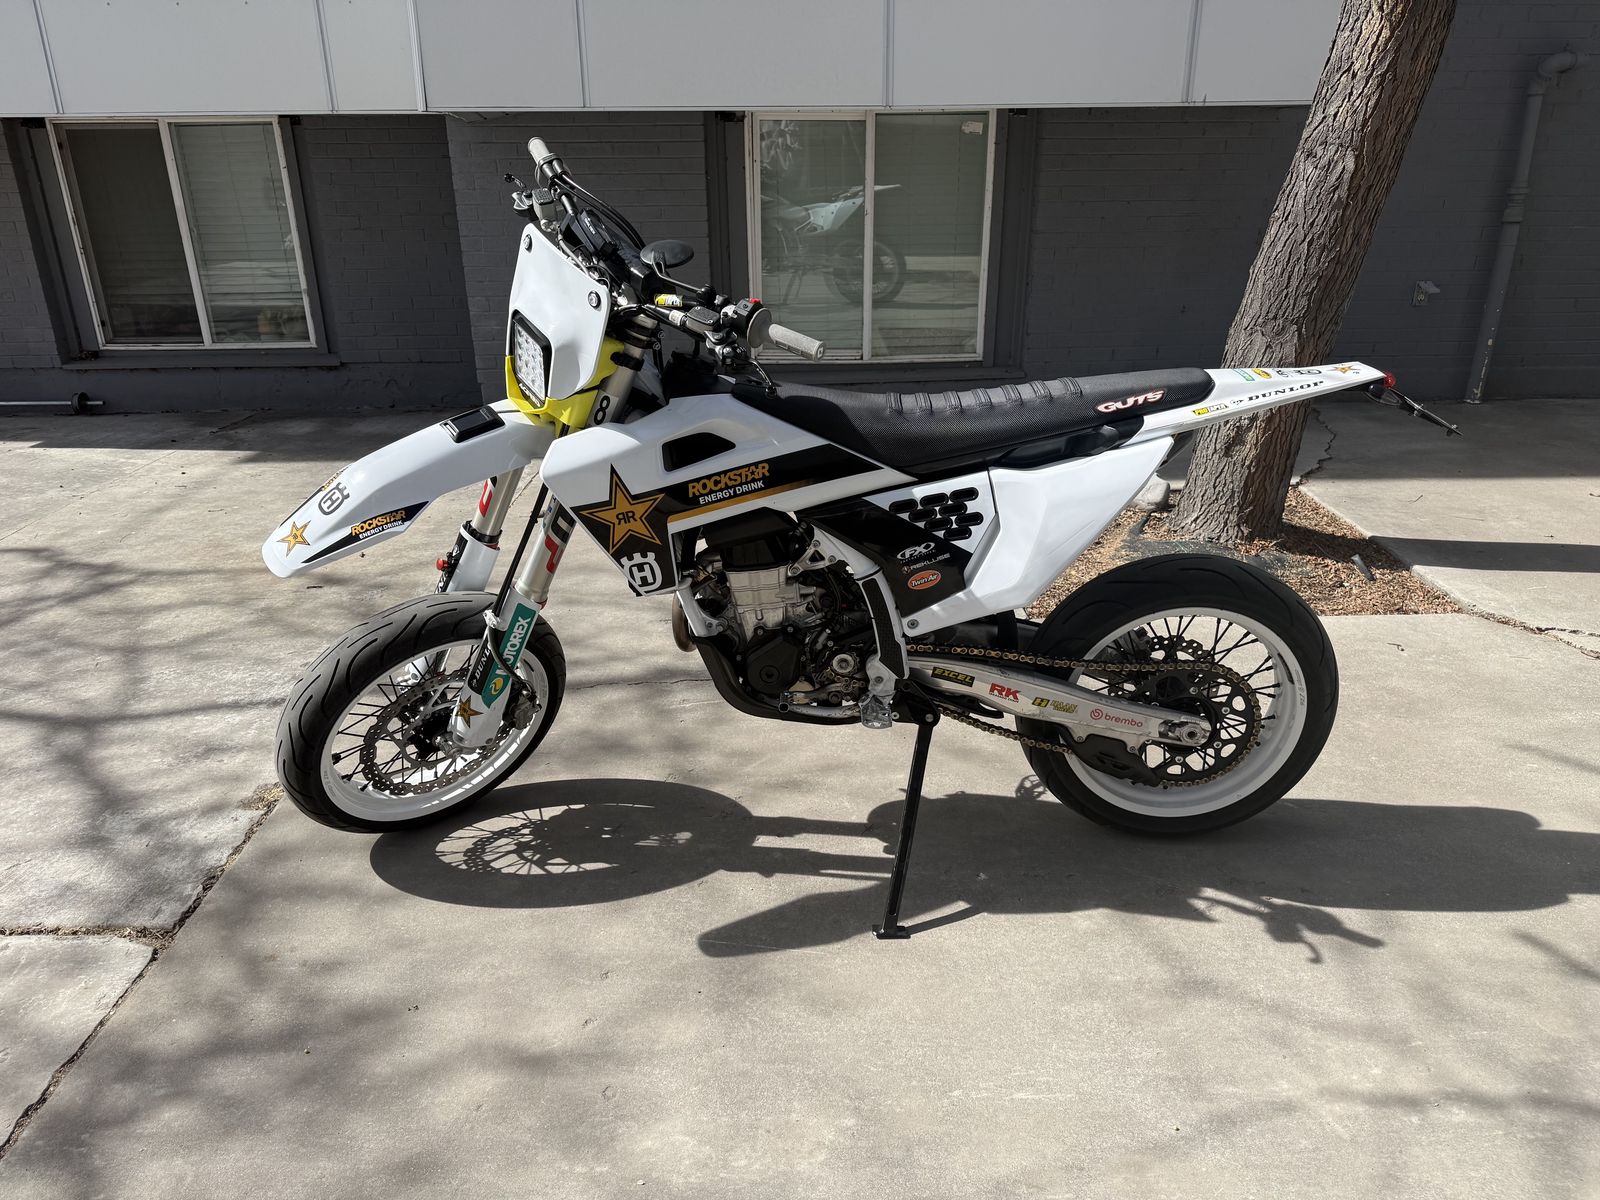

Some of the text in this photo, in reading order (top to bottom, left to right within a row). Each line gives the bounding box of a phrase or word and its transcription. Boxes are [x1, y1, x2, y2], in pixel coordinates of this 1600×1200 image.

[1097, 390, 1165, 413] GUTS
[1248, 381, 1324, 401] DUNLOP
[688, 463, 770, 498] ROCKSTAR
[699, 480, 765, 505] ENERGY DRINK
[351, 510, 407, 537] ROCKSTAR
[359, 519, 403, 540] ENERGY DRINK
[910, 552, 951, 570] REKLUSE
[474, 648, 491, 681] DUNL
[934, 668, 973, 683] EXCEL
[989, 682, 1021, 701] RK
[1104, 713, 1143, 728] brembo
